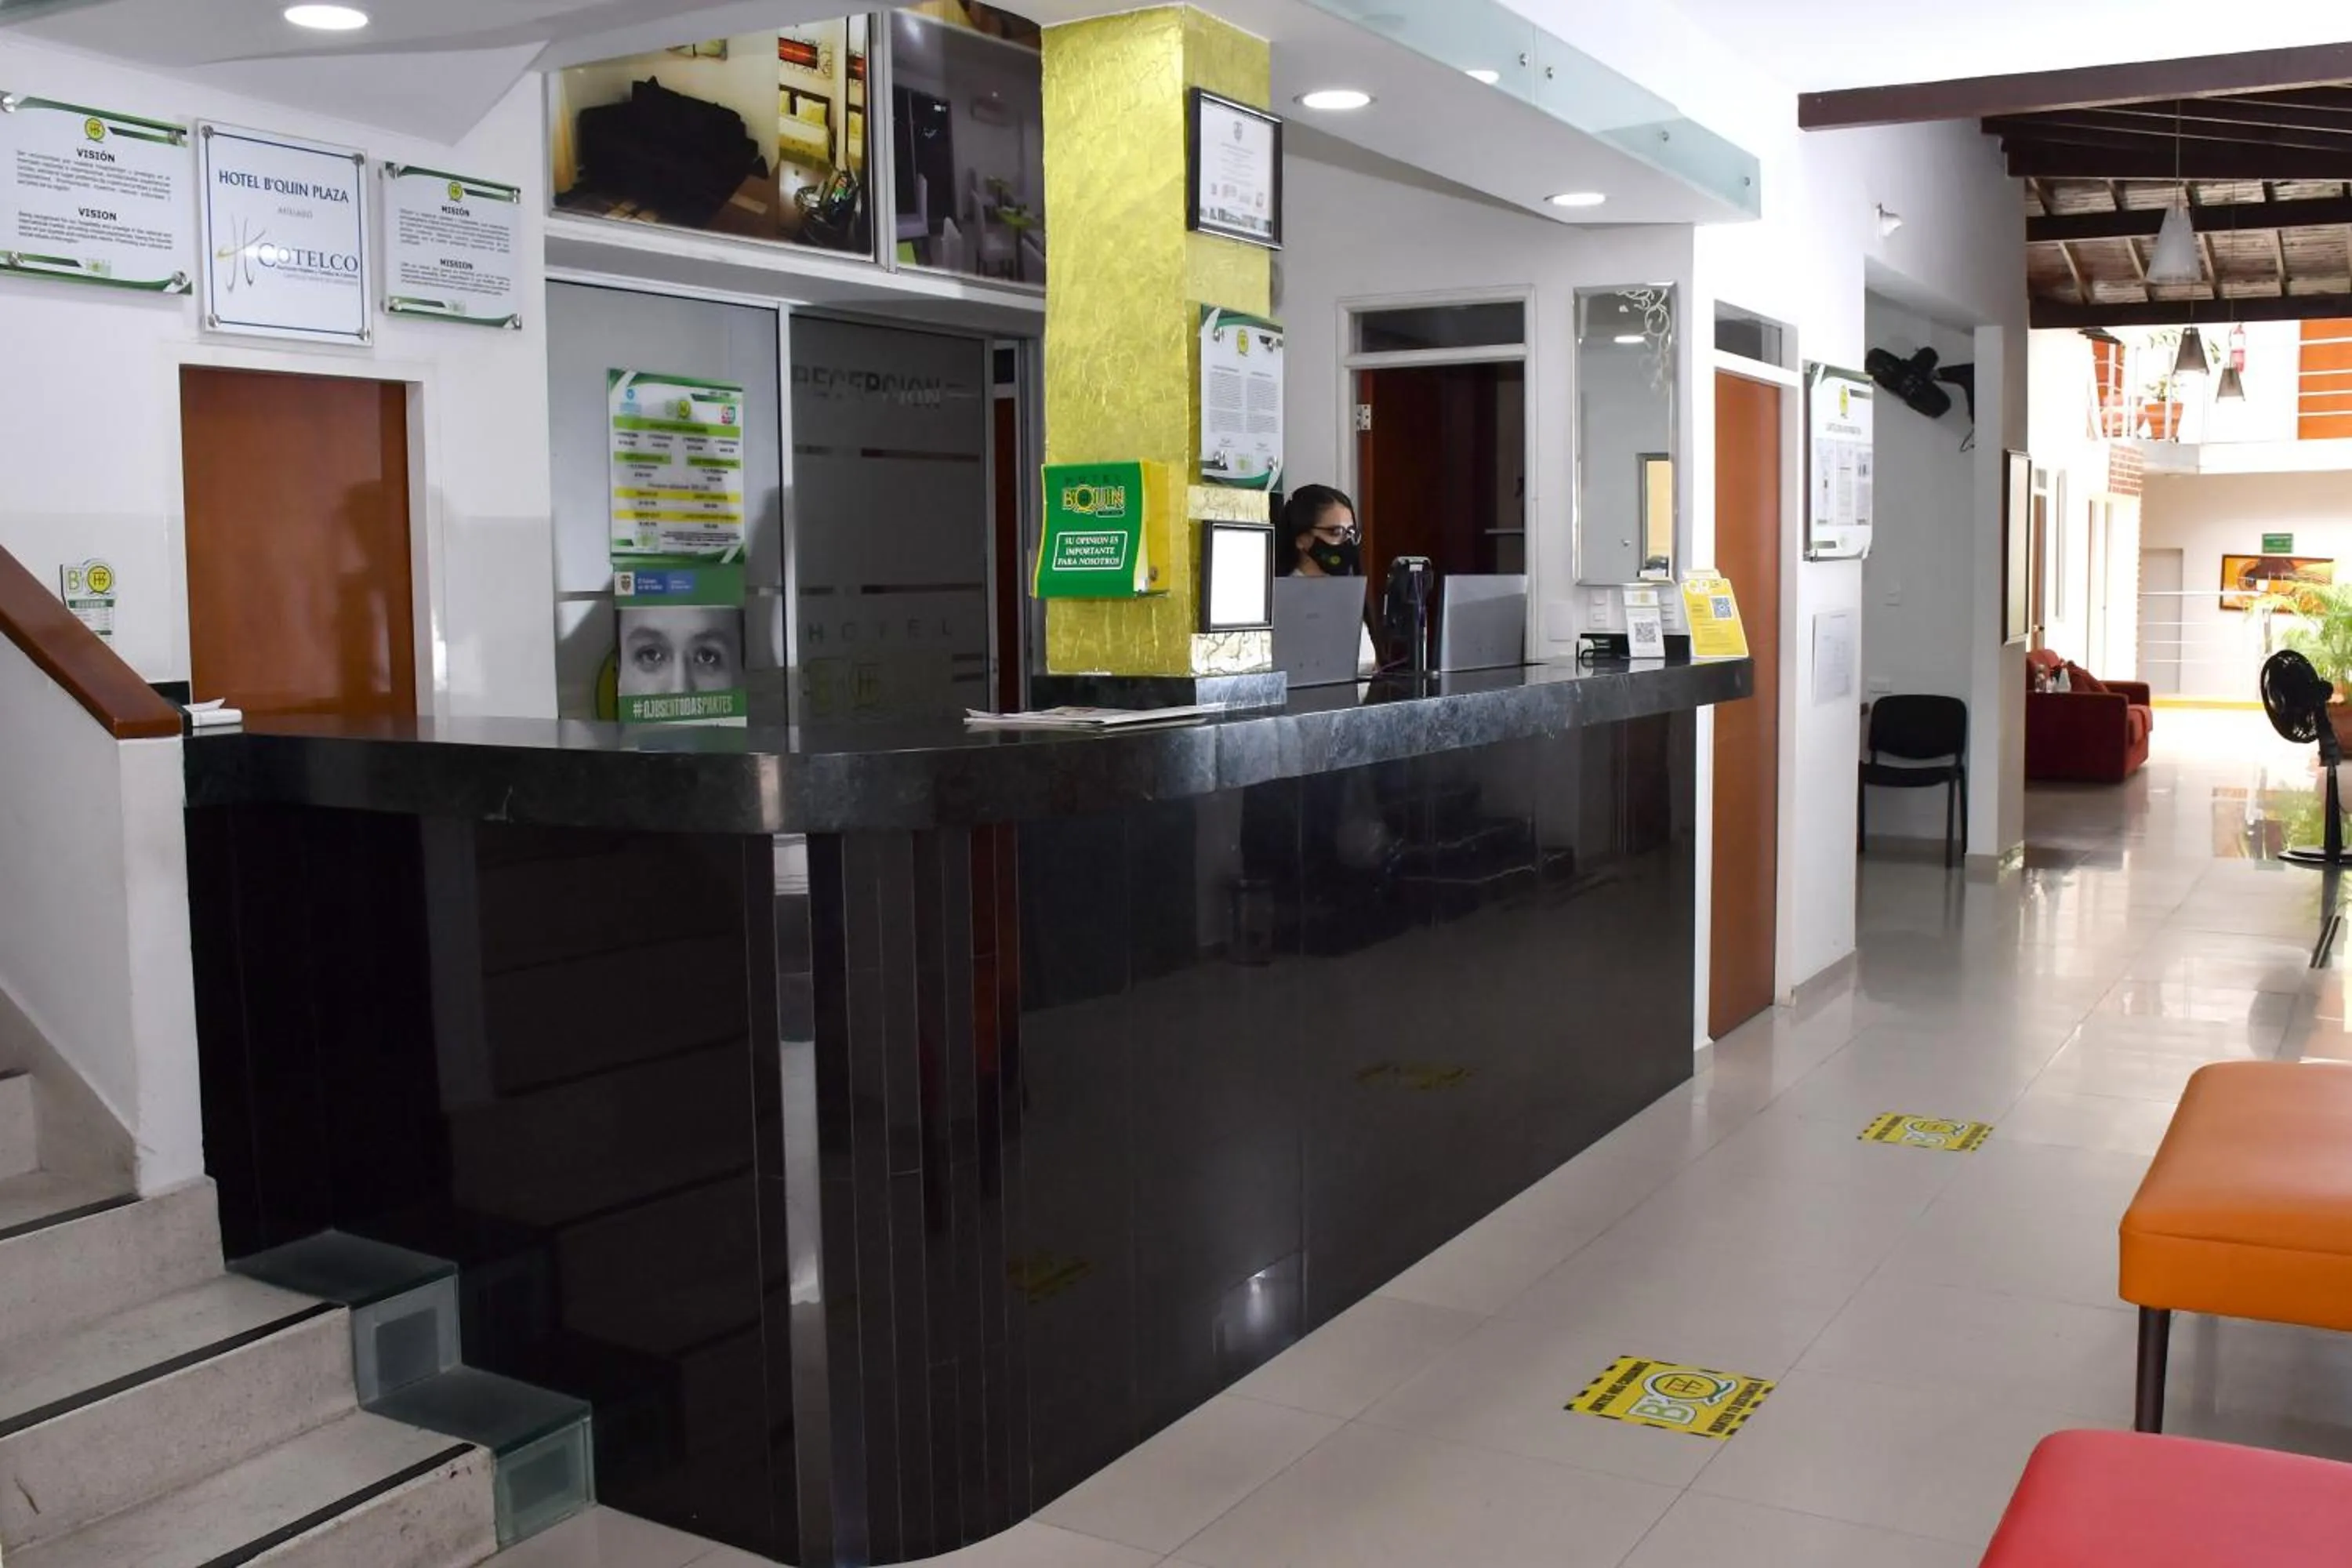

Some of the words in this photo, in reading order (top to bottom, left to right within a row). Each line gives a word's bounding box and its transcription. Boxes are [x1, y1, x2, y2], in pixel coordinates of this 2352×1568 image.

[77, 147, 115, 162] VISIÓN
[219, 170, 260, 189] HOTEL
[264, 177, 308, 197] B'QUIN
[313, 185, 349, 203] PLAZA
[78, 208, 117, 220] VISION
[257, 242, 358, 272] COTELCO
